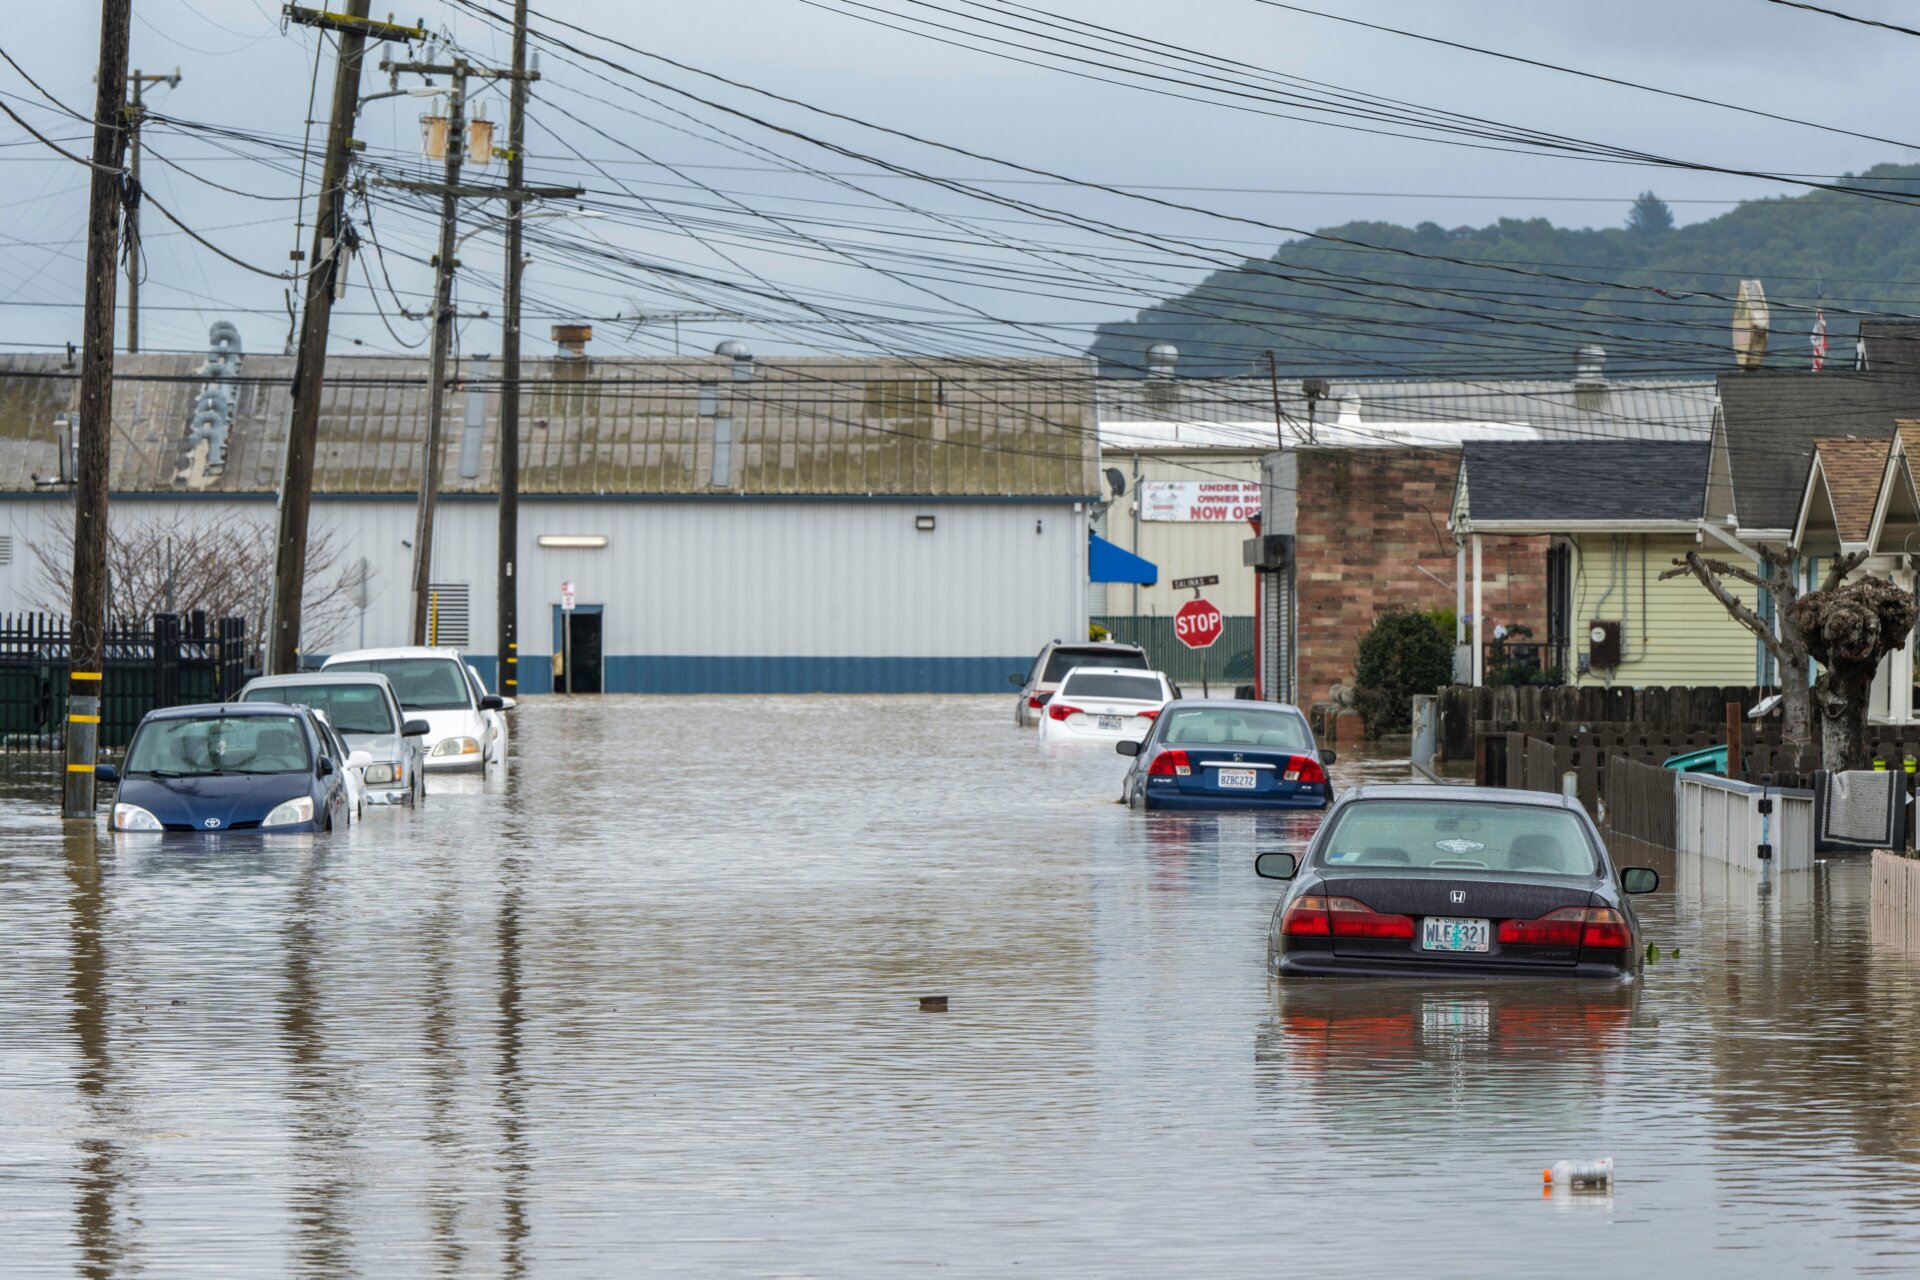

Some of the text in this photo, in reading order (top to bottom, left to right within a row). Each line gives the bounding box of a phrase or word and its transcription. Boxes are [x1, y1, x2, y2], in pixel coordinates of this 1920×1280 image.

[1190, 506, 1227, 520] NOW
[1178, 612, 1218, 634] STOP
[1221, 776, 1254, 786] 8ZBC272
[1462, 926, 1485, 944] 321
